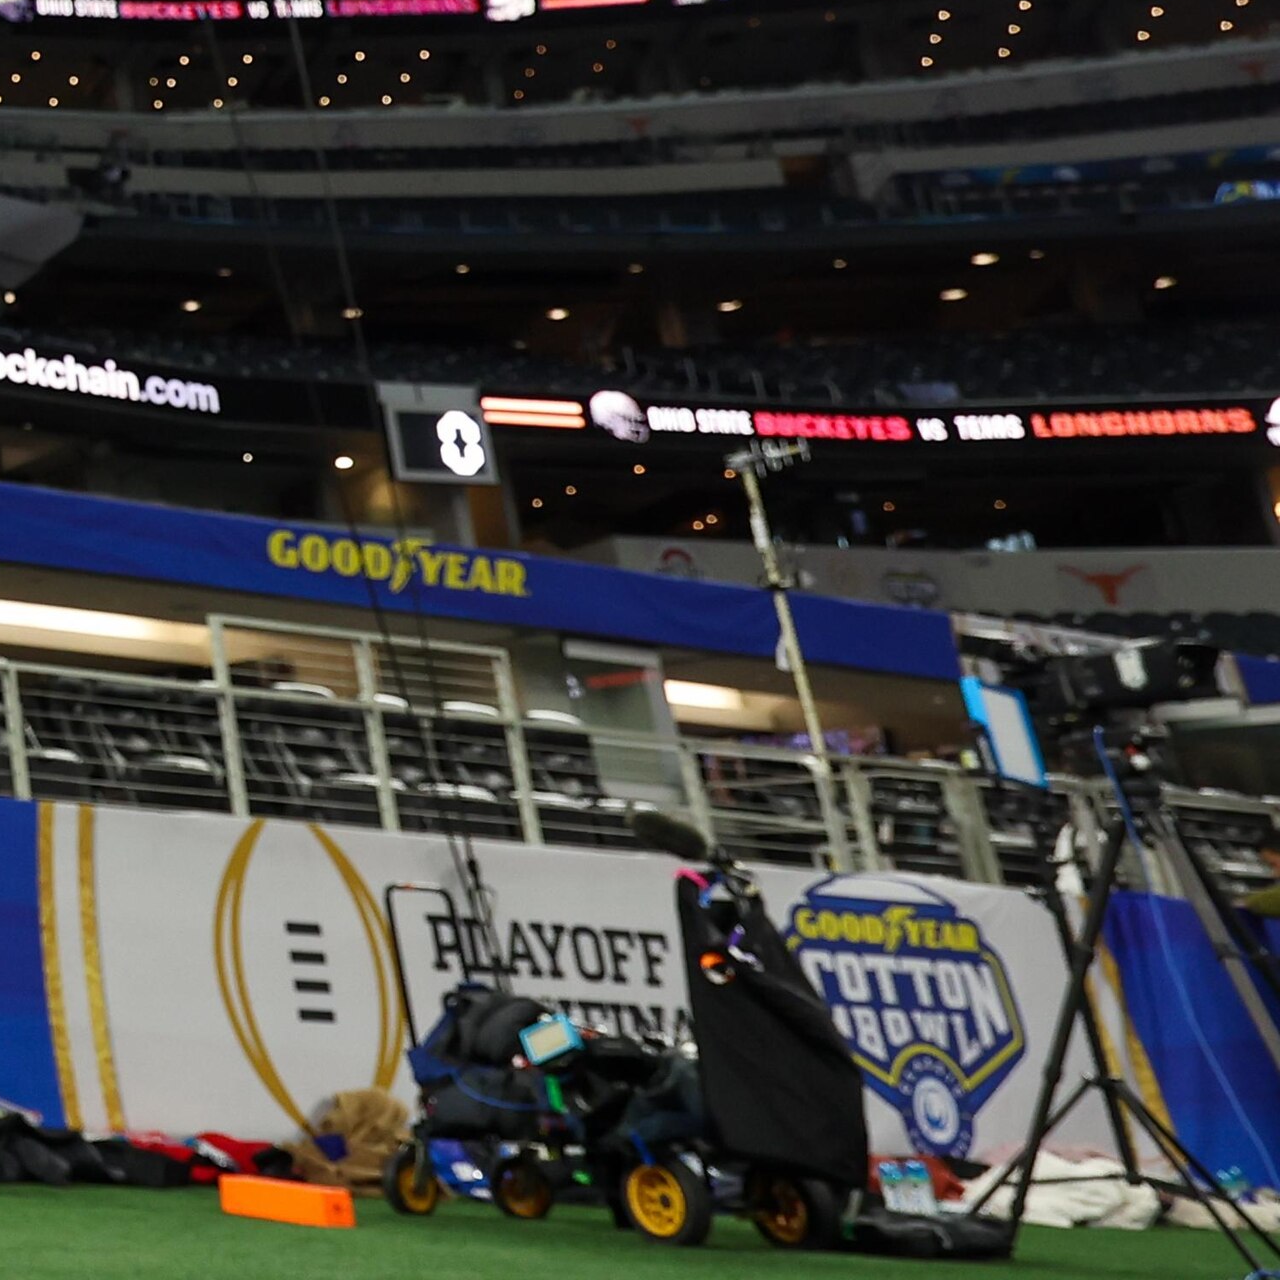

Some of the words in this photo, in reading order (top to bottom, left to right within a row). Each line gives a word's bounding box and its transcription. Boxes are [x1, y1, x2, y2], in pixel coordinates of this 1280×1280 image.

[917, 417, 949, 441] VS
[426, 914, 669, 987] PLAYOFF
[849, 1004, 983, 1067] BOWL
